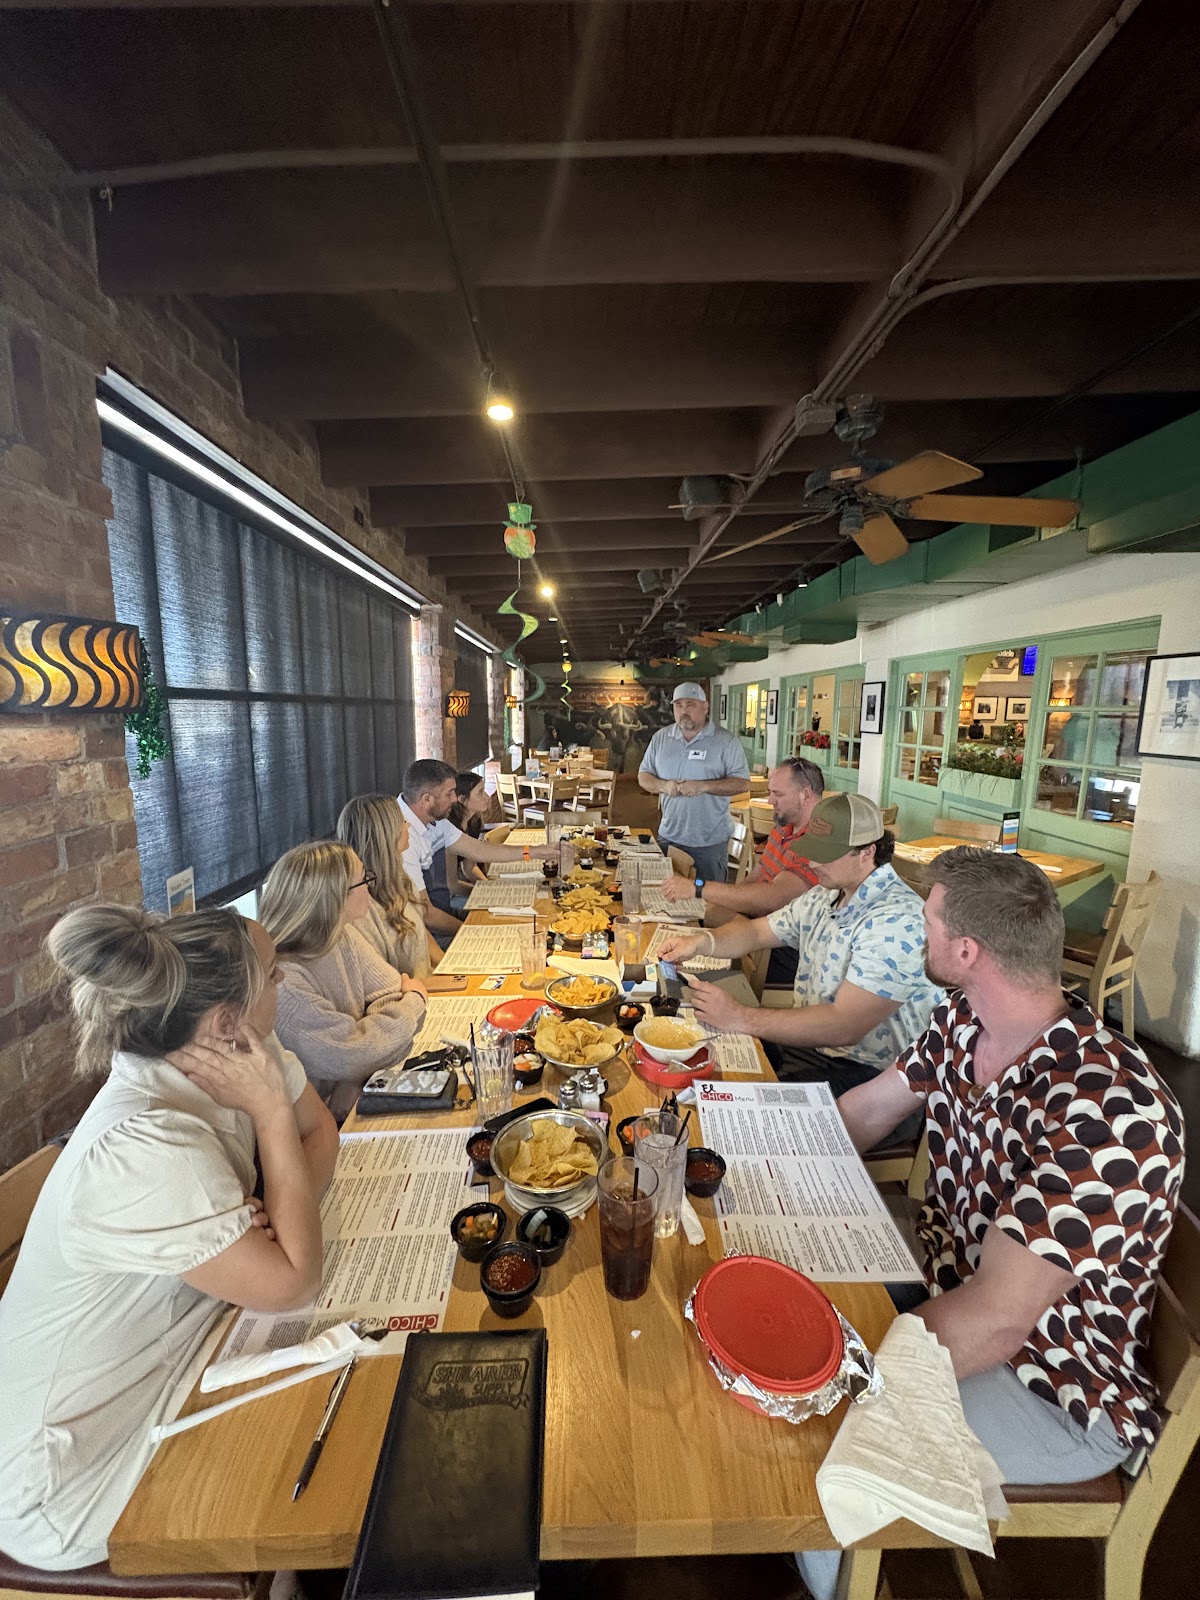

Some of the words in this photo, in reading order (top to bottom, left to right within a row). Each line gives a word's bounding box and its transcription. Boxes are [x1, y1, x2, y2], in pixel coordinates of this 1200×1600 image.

[701, 1083, 716, 1093] El
[701, 1092, 733, 1101] CHICO
[389, 1315, 437, 1331] CHICO
[472, 1381, 515, 1396] SUPPLY
